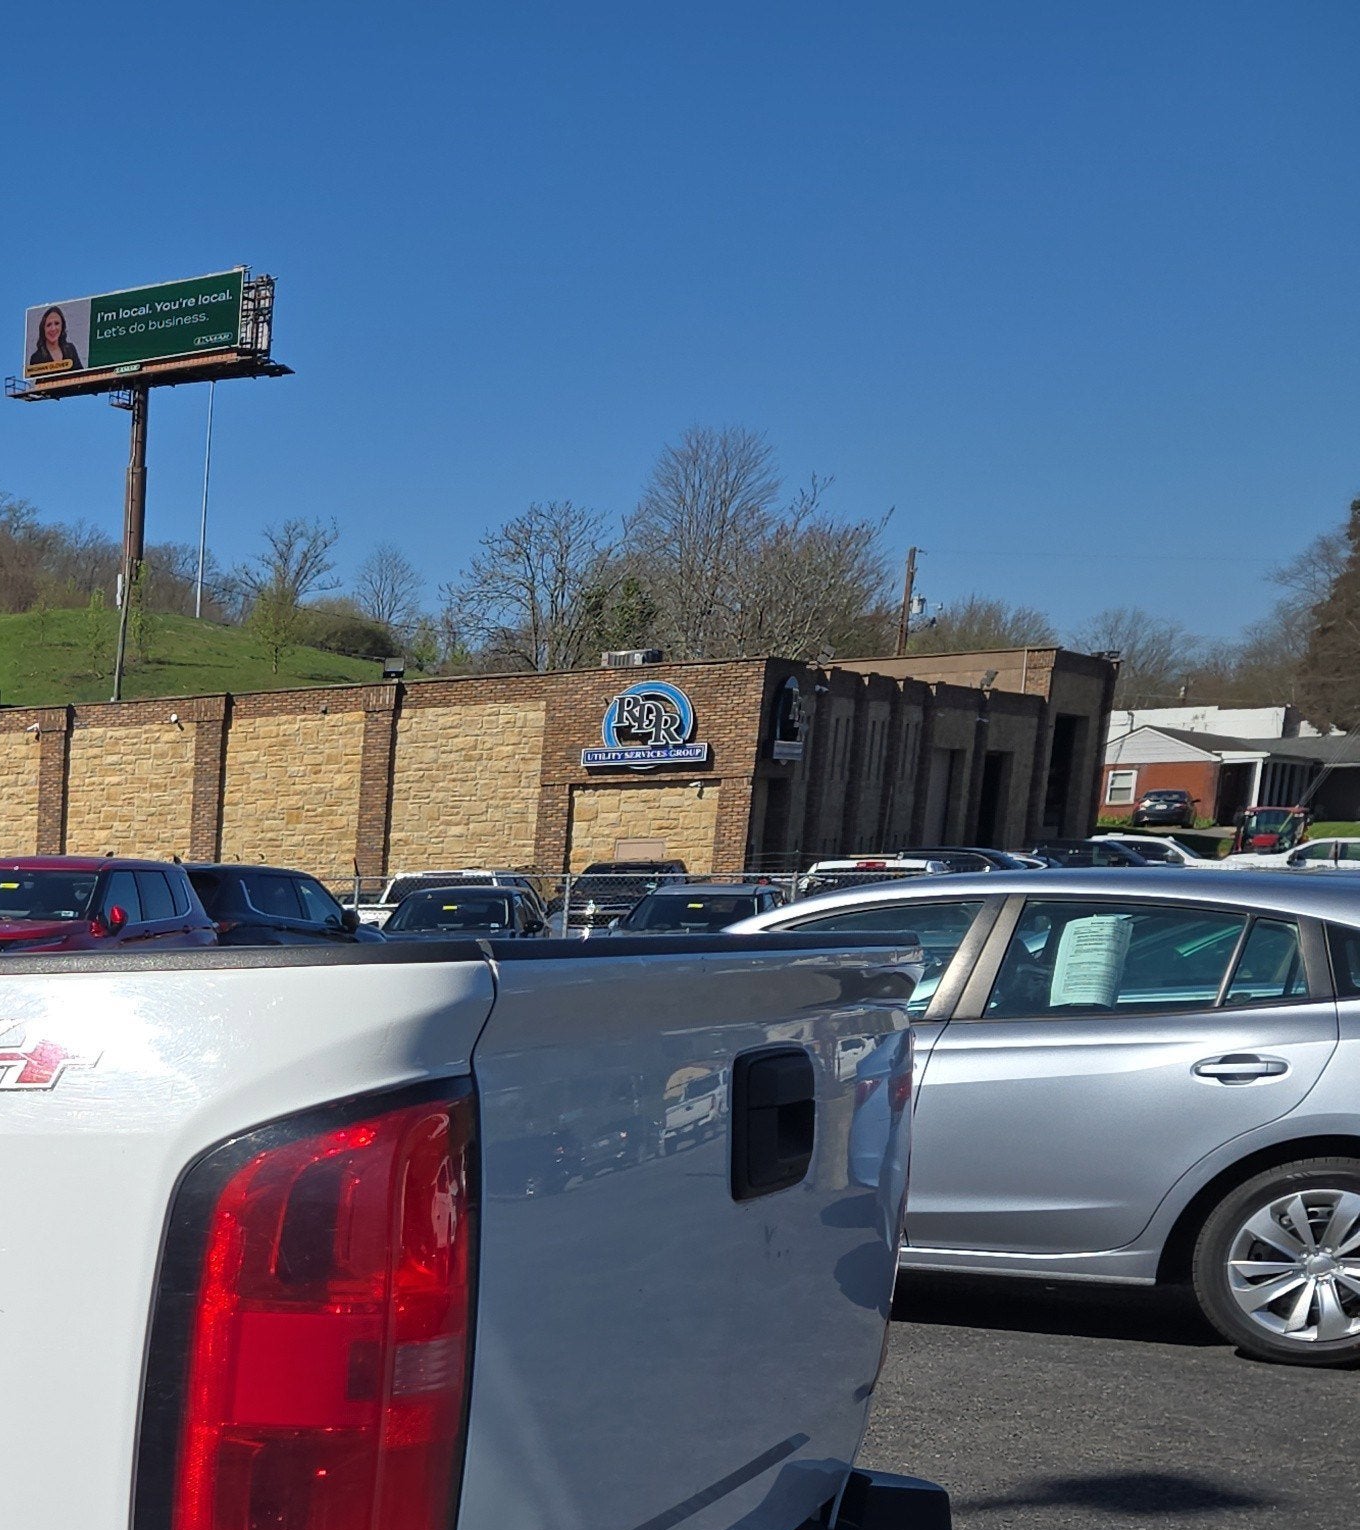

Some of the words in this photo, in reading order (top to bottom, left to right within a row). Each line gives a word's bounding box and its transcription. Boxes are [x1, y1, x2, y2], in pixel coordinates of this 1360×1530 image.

[97, 312, 117, 322] I'm
[120, 304, 152, 318] local.
[155, 298, 195, 312] You're
[198, 290, 232, 305] local.
[96, 325, 126, 339] Let's
[129, 322, 145, 333] do
[149, 312, 209, 330] business.
[612, 694, 683, 745] RDR
[587, 752, 622, 761] UTILITY
[624, 750, 668, 760] SERVICES
[669, 748, 702, 758] GROUP
